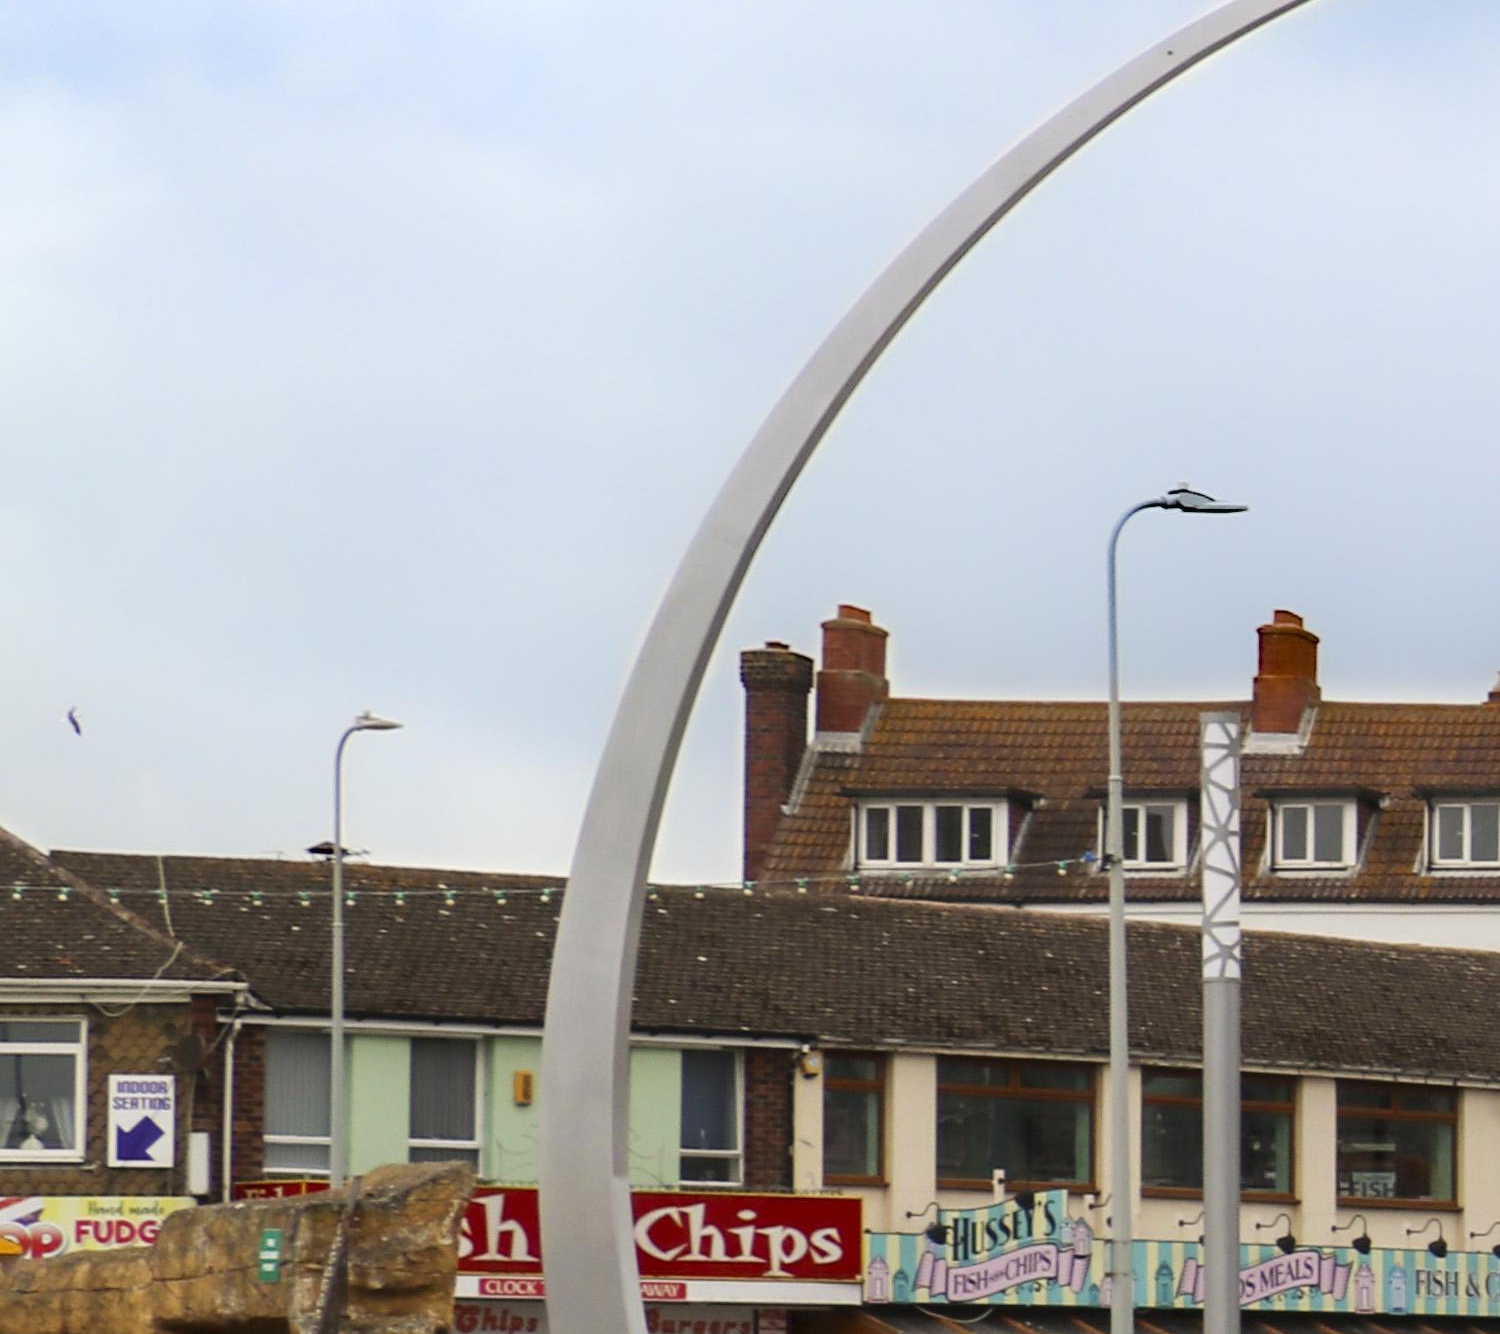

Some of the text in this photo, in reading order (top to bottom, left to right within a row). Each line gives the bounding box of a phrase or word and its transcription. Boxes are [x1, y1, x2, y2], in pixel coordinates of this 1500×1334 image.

[116, 1081, 168, 1095] INDOOR
[112, 1097, 172, 1111] SEATING
[75, 1219, 161, 1244] FUDG
[634, 1202, 844, 1278] Chips
[951, 1199, 1057, 1262] HUSSEY'S
[953, 1270, 988, 1295] FISH
[1004, 1250, 1053, 1281] CHIPS
[1259, 1255, 1315, 1291] MEALS
[1415, 1269, 1458, 1297] FISH
[1465, 1271, 1480, 1298] &
[484, 1280, 538, 1295] CLOCK
[640, 1284, 680, 1298] AWAY
[455, 1303, 538, 1334] Chips
